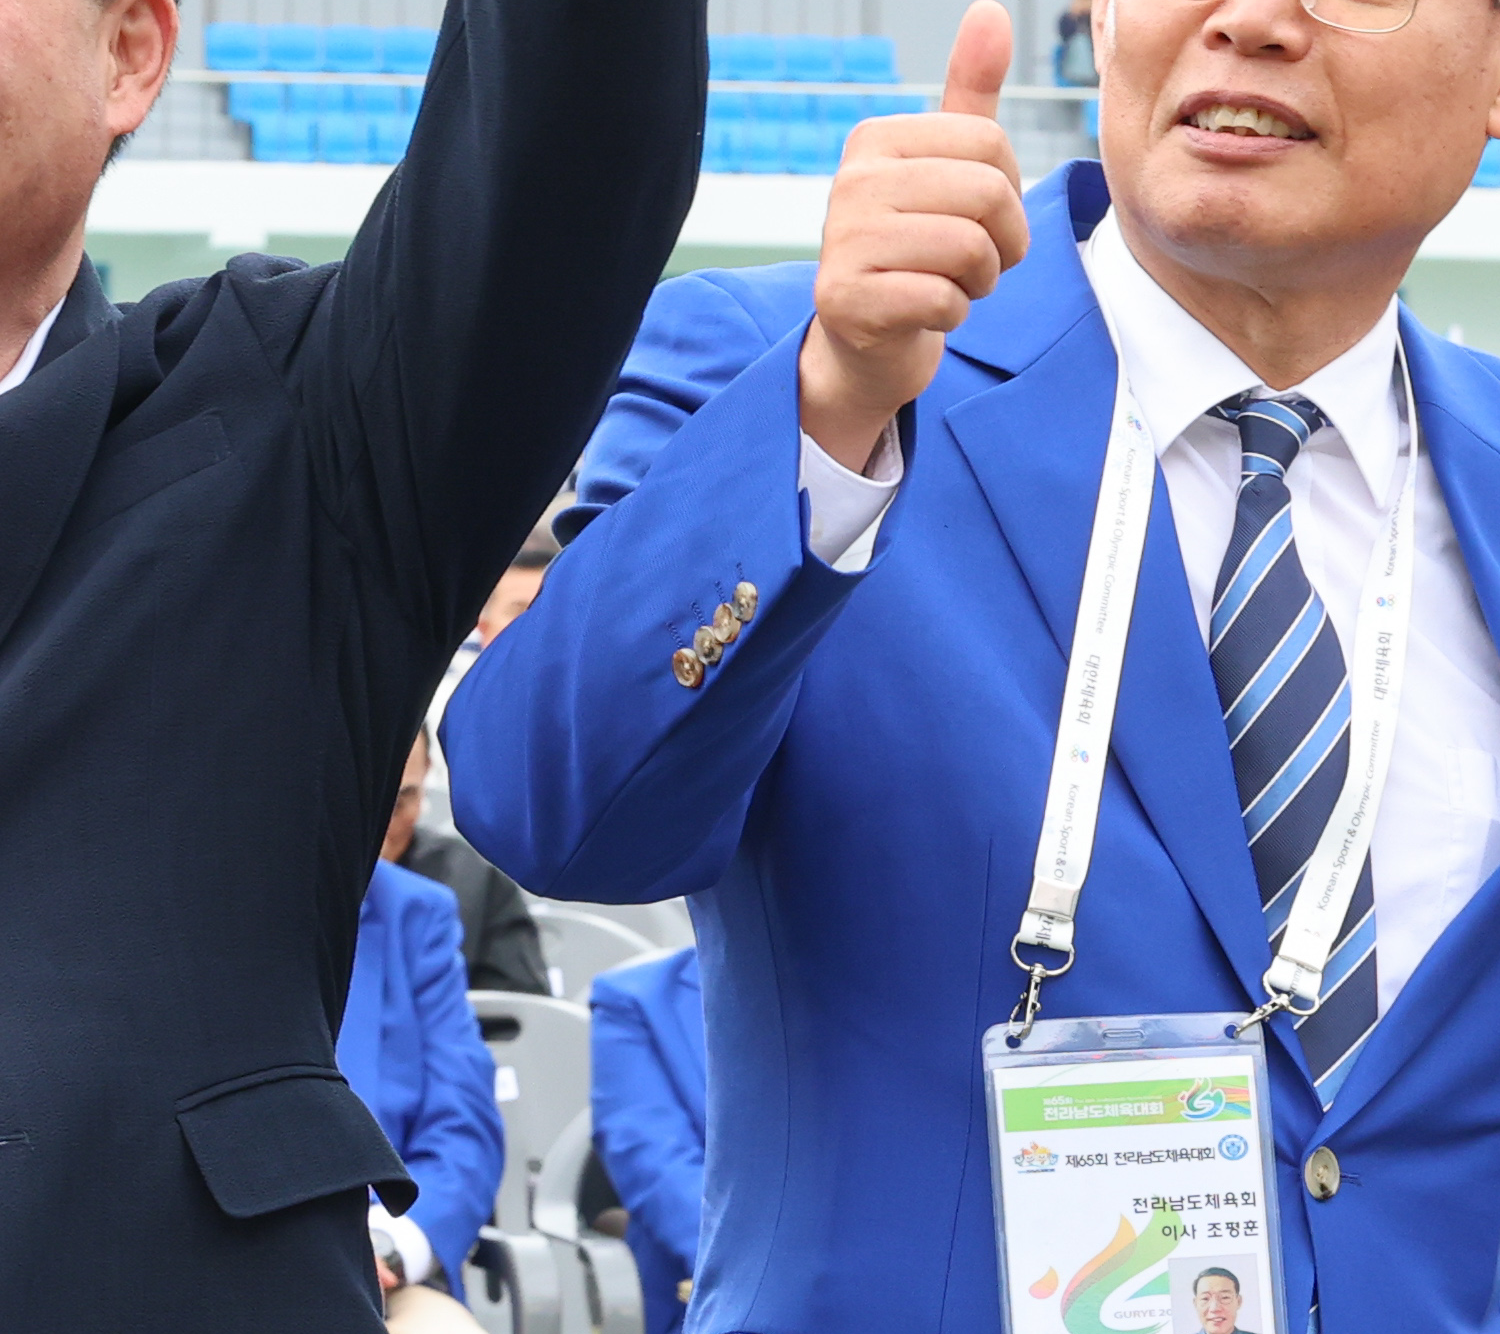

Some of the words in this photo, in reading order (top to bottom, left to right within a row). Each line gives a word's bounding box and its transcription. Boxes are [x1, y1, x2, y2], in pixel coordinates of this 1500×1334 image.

[1122, 448, 1136, 484] Korean
[1116, 487, 1130, 516] Sport
[1106, 529, 1124, 571] Olympic
[1095, 575, 1115, 635] Committee
[1373, 631, 1393, 700] 대한체육회
[1076, 654, 1101, 724] 대한체육회
[1365, 720, 1381, 779] Committee
[1064, 784, 1080, 822] Korean
[1351, 782, 1372, 827] Olympic
[1057, 825, 1073, 855] Sport
[1347, 828, 1356, 838] &
[1056, 858, 1067, 866] &
[1332, 838, 1356, 869] Sport
[1316, 872, 1340, 911] Korean
[1043, 1102, 1164, 1121] 전라남도체육대회
[1065, 1153, 1108, 1168] 제65회
[1114, 1147, 1216, 1166] 전라남도체육대회
[1132, 1191, 1257, 1214] 전라남도체육회
[1161, 1224, 1197, 1241] 이사
[1207, 1220, 1259, 1238] 조평훈
[1113, 1308, 1156, 1319] GURYE
